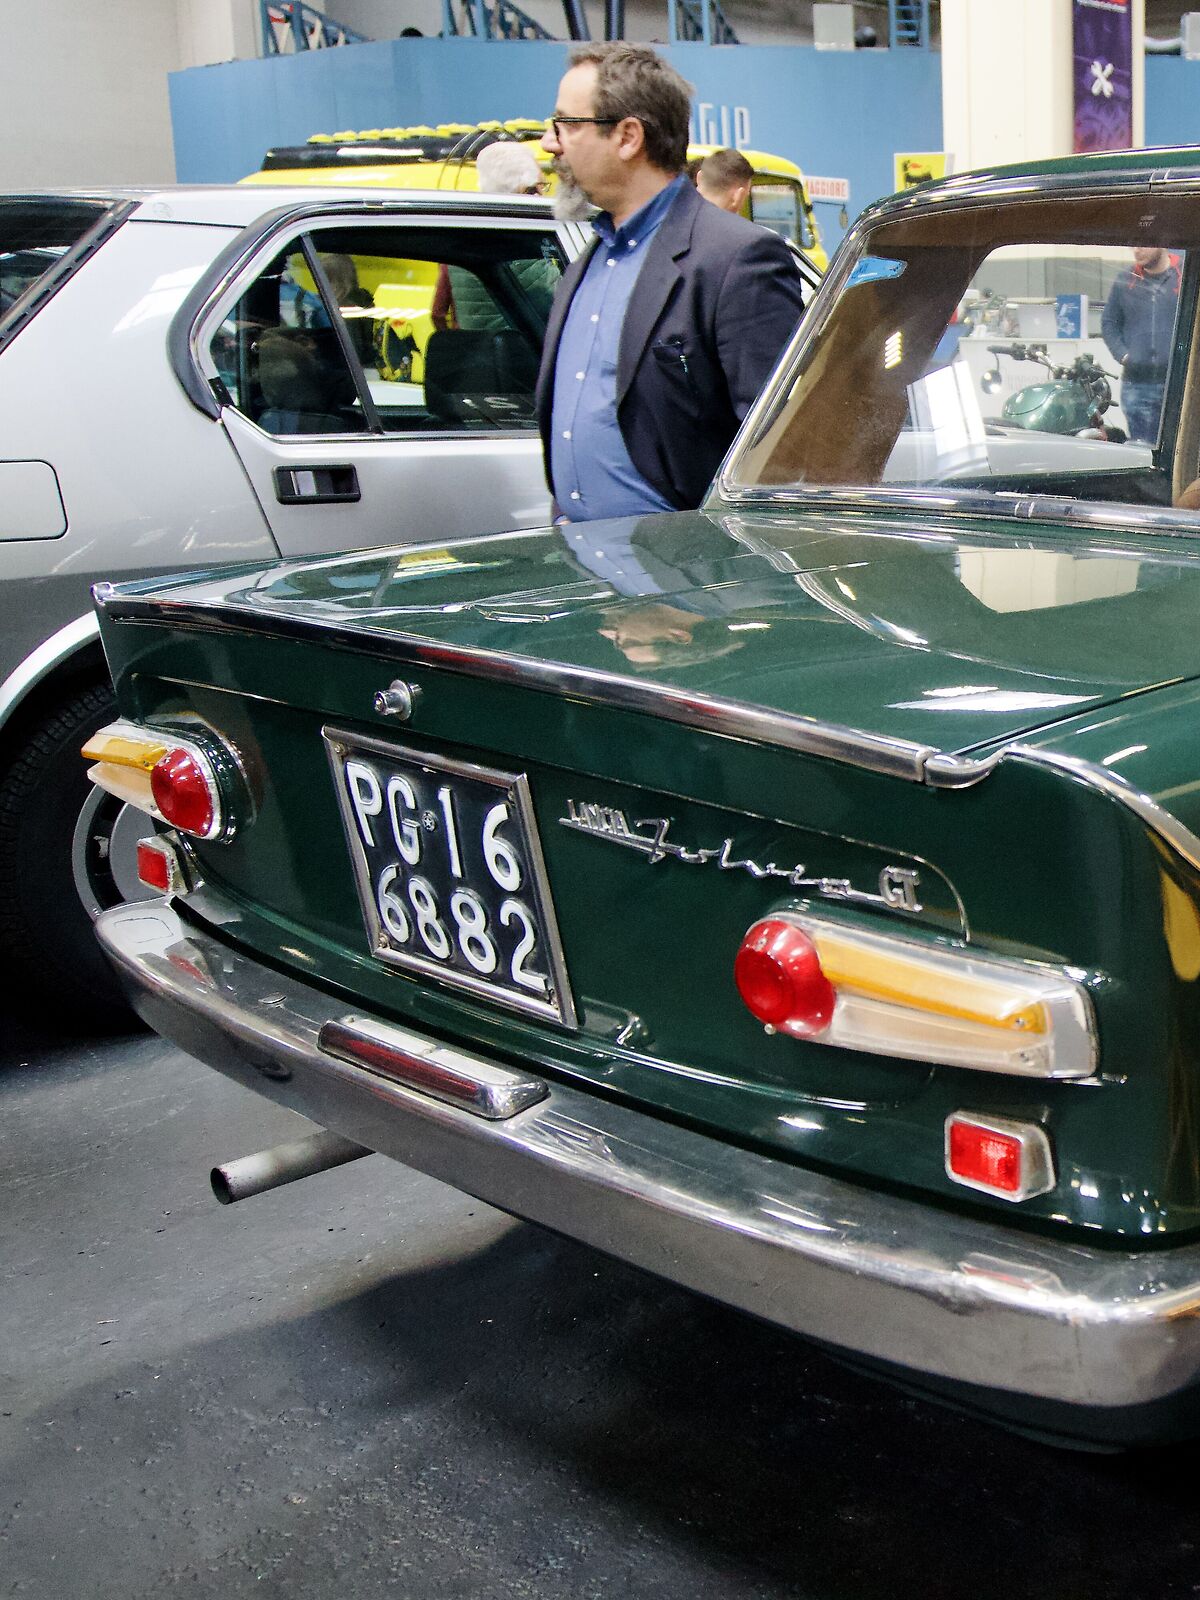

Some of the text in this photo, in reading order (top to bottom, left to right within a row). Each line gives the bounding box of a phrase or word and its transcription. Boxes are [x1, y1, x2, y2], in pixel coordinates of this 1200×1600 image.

[566, 799, 634, 837] LANCIA
[879, 865, 923, 913] GT
[377, 862, 549, 992] 6882
